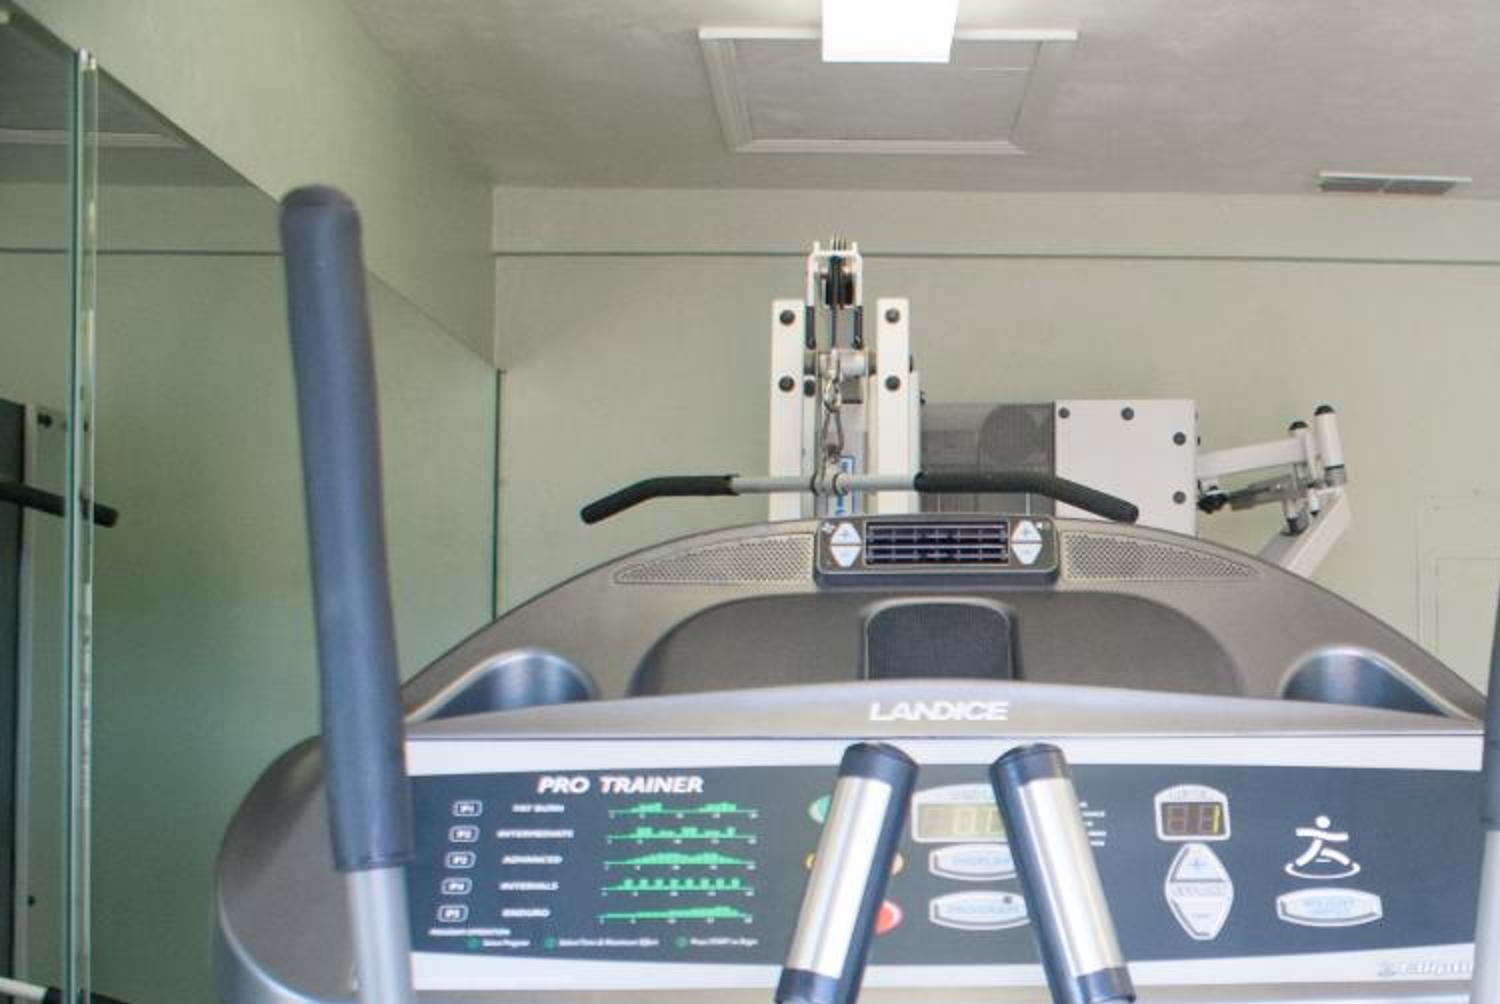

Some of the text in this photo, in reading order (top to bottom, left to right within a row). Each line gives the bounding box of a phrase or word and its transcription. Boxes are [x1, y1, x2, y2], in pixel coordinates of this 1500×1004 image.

[868, 700, 1010, 722] LANDICE
[537, 775, 705, 795] PRO TRAINER
[496, 829, 575, 839] INTERMEDIATE
[501, 855, 564, 865] ADVANCED
[499, 881, 560, 891] INTERVALS
